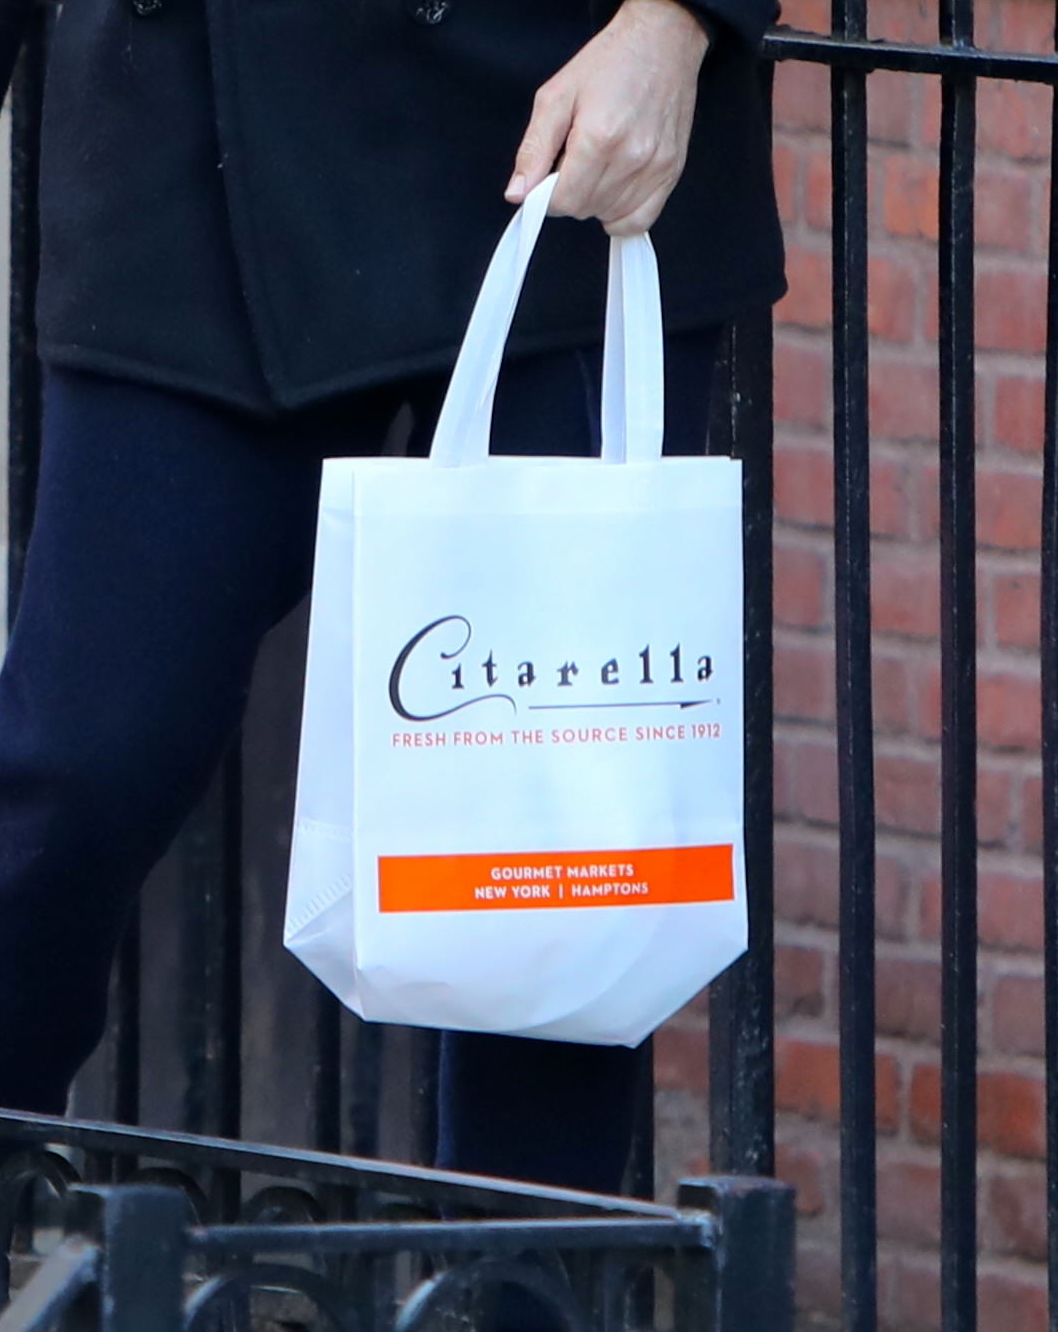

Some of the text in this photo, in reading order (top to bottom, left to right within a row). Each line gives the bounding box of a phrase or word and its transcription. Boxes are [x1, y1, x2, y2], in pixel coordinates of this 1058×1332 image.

[388, 614, 714, 722] Citarella
[392, 722, 721, 747] FRESH FROM THE SOURCE SINCE 1912
[490, 863, 635, 881] GOURMET MARKETS
[474, 881, 650, 900] NEW YORK HAMPTONS
